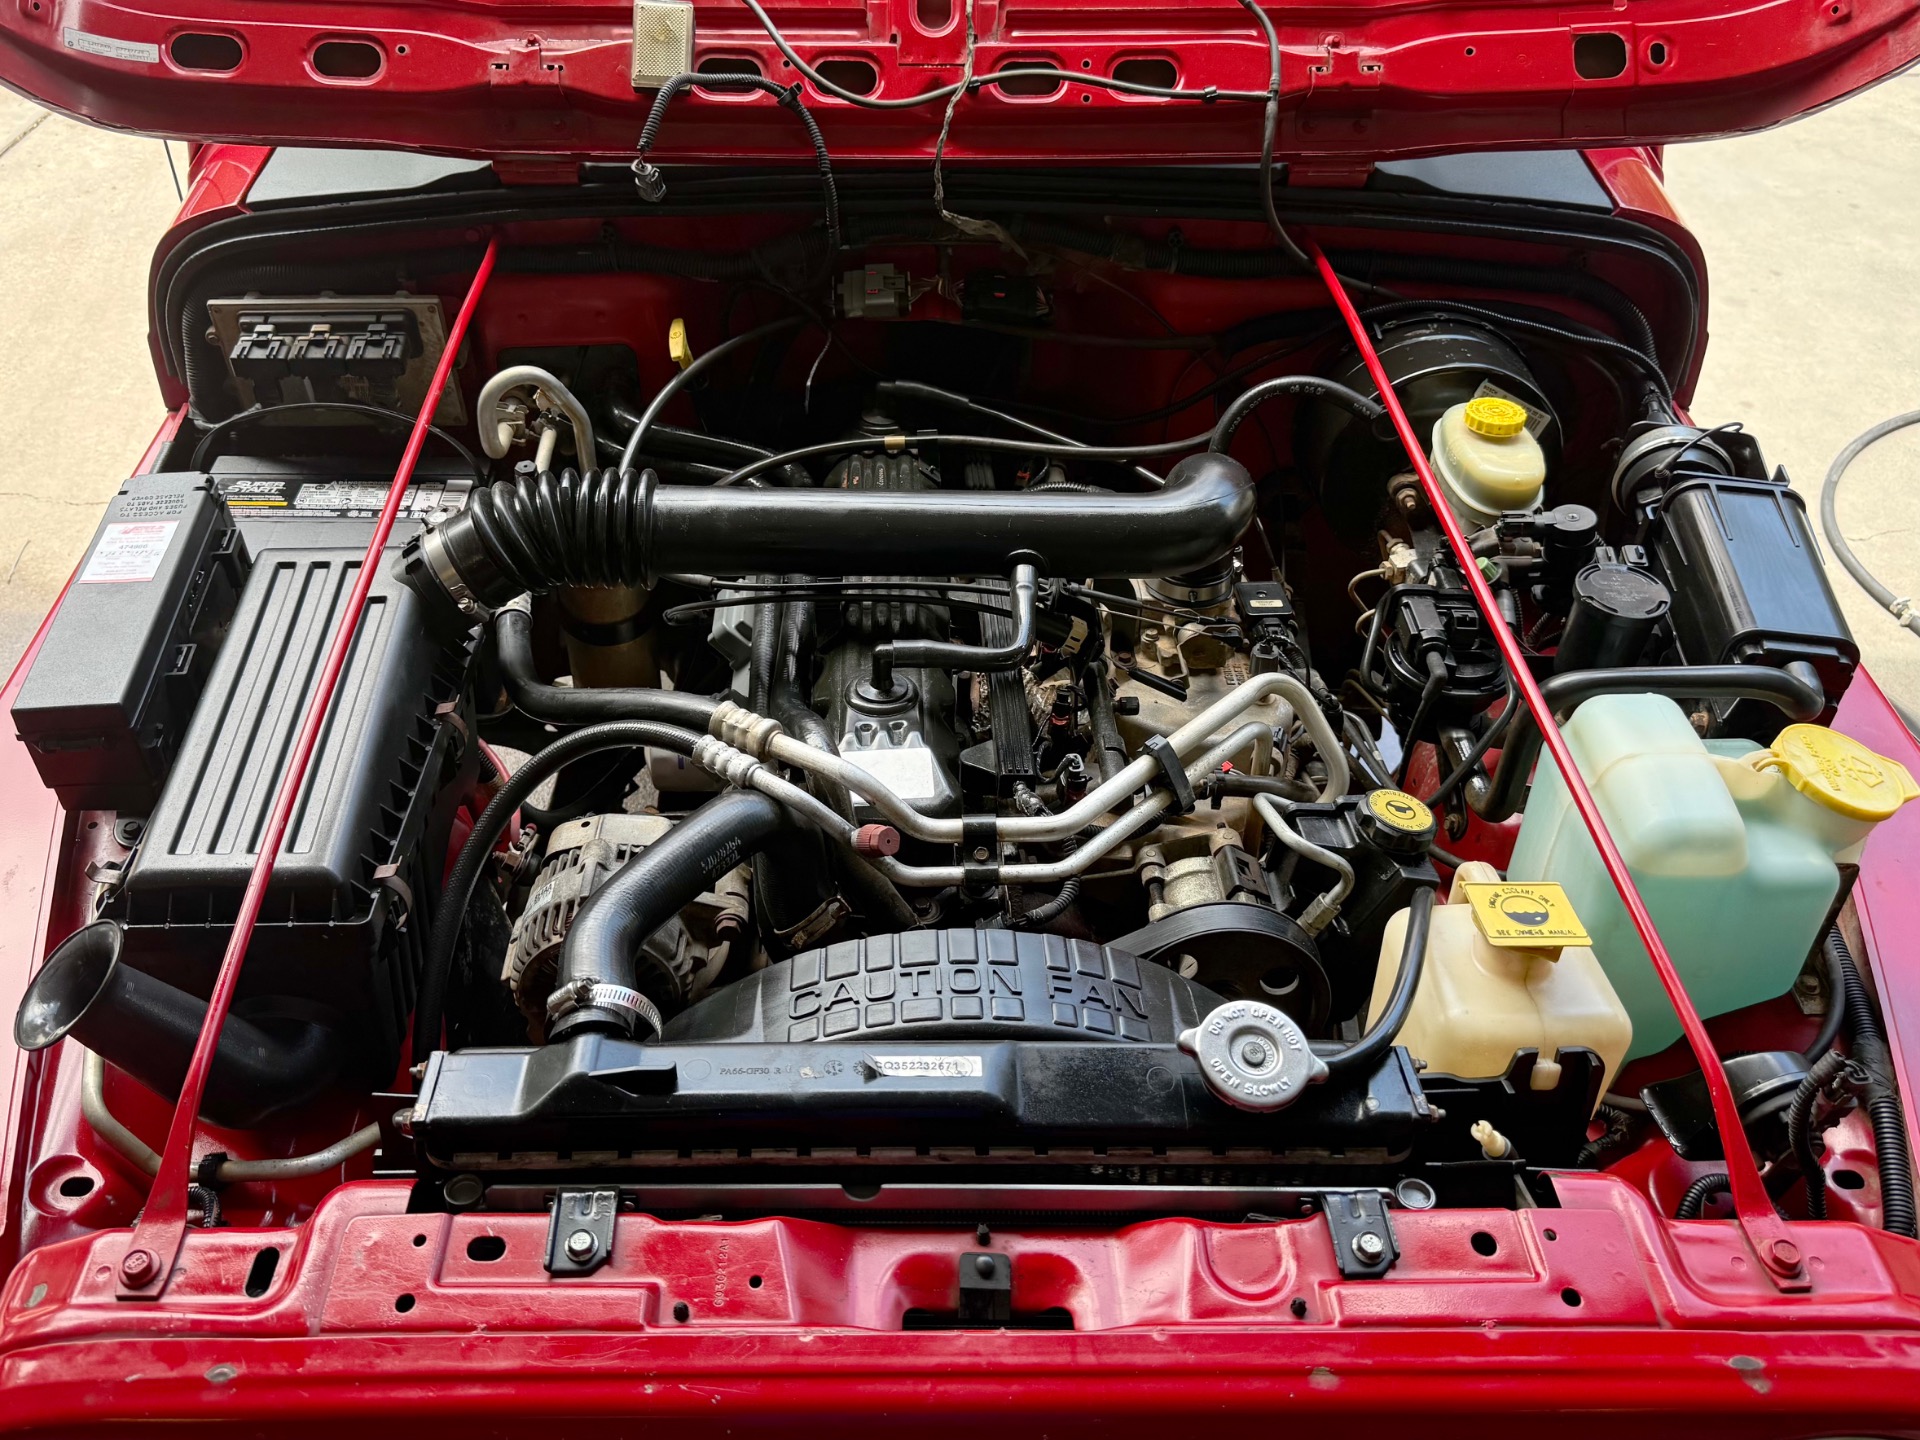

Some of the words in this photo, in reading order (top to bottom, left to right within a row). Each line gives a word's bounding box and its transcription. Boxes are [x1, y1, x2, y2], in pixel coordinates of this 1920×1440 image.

[225, 486, 280, 494] START
[235, 480, 286, 488] SUPER
[788, 966, 1023, 1019] CAUTION
[1049, 973, 1149, 1019] FAN
[1208, 1018, 1224, 1036] DO
[1222, 1006, 1247, 1023] NOT
[1250, 1006, 1285, 1031] OPEN
[1283, 1026, 1302, 1052] HOT
[1210, 1057, 1241, 1089] OPEN
[1243, 1075, 1292, 1097] SLOWLY
